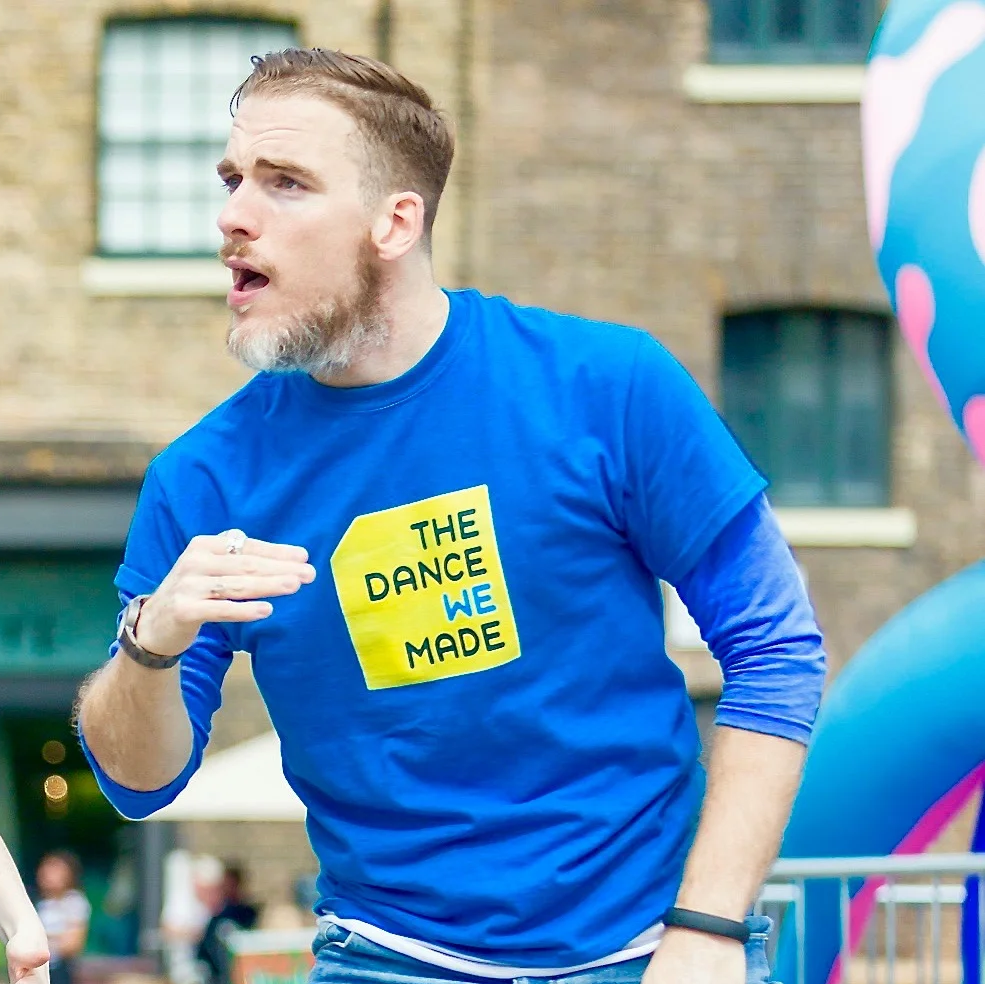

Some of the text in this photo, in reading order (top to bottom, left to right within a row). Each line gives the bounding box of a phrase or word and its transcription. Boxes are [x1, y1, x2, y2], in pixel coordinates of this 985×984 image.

[410, 508, 479, 550] THE
[364, 546, 487, 602] DANCE
[443, 583, 496, 621] WE
[404, 620, 505, 669] MADE
